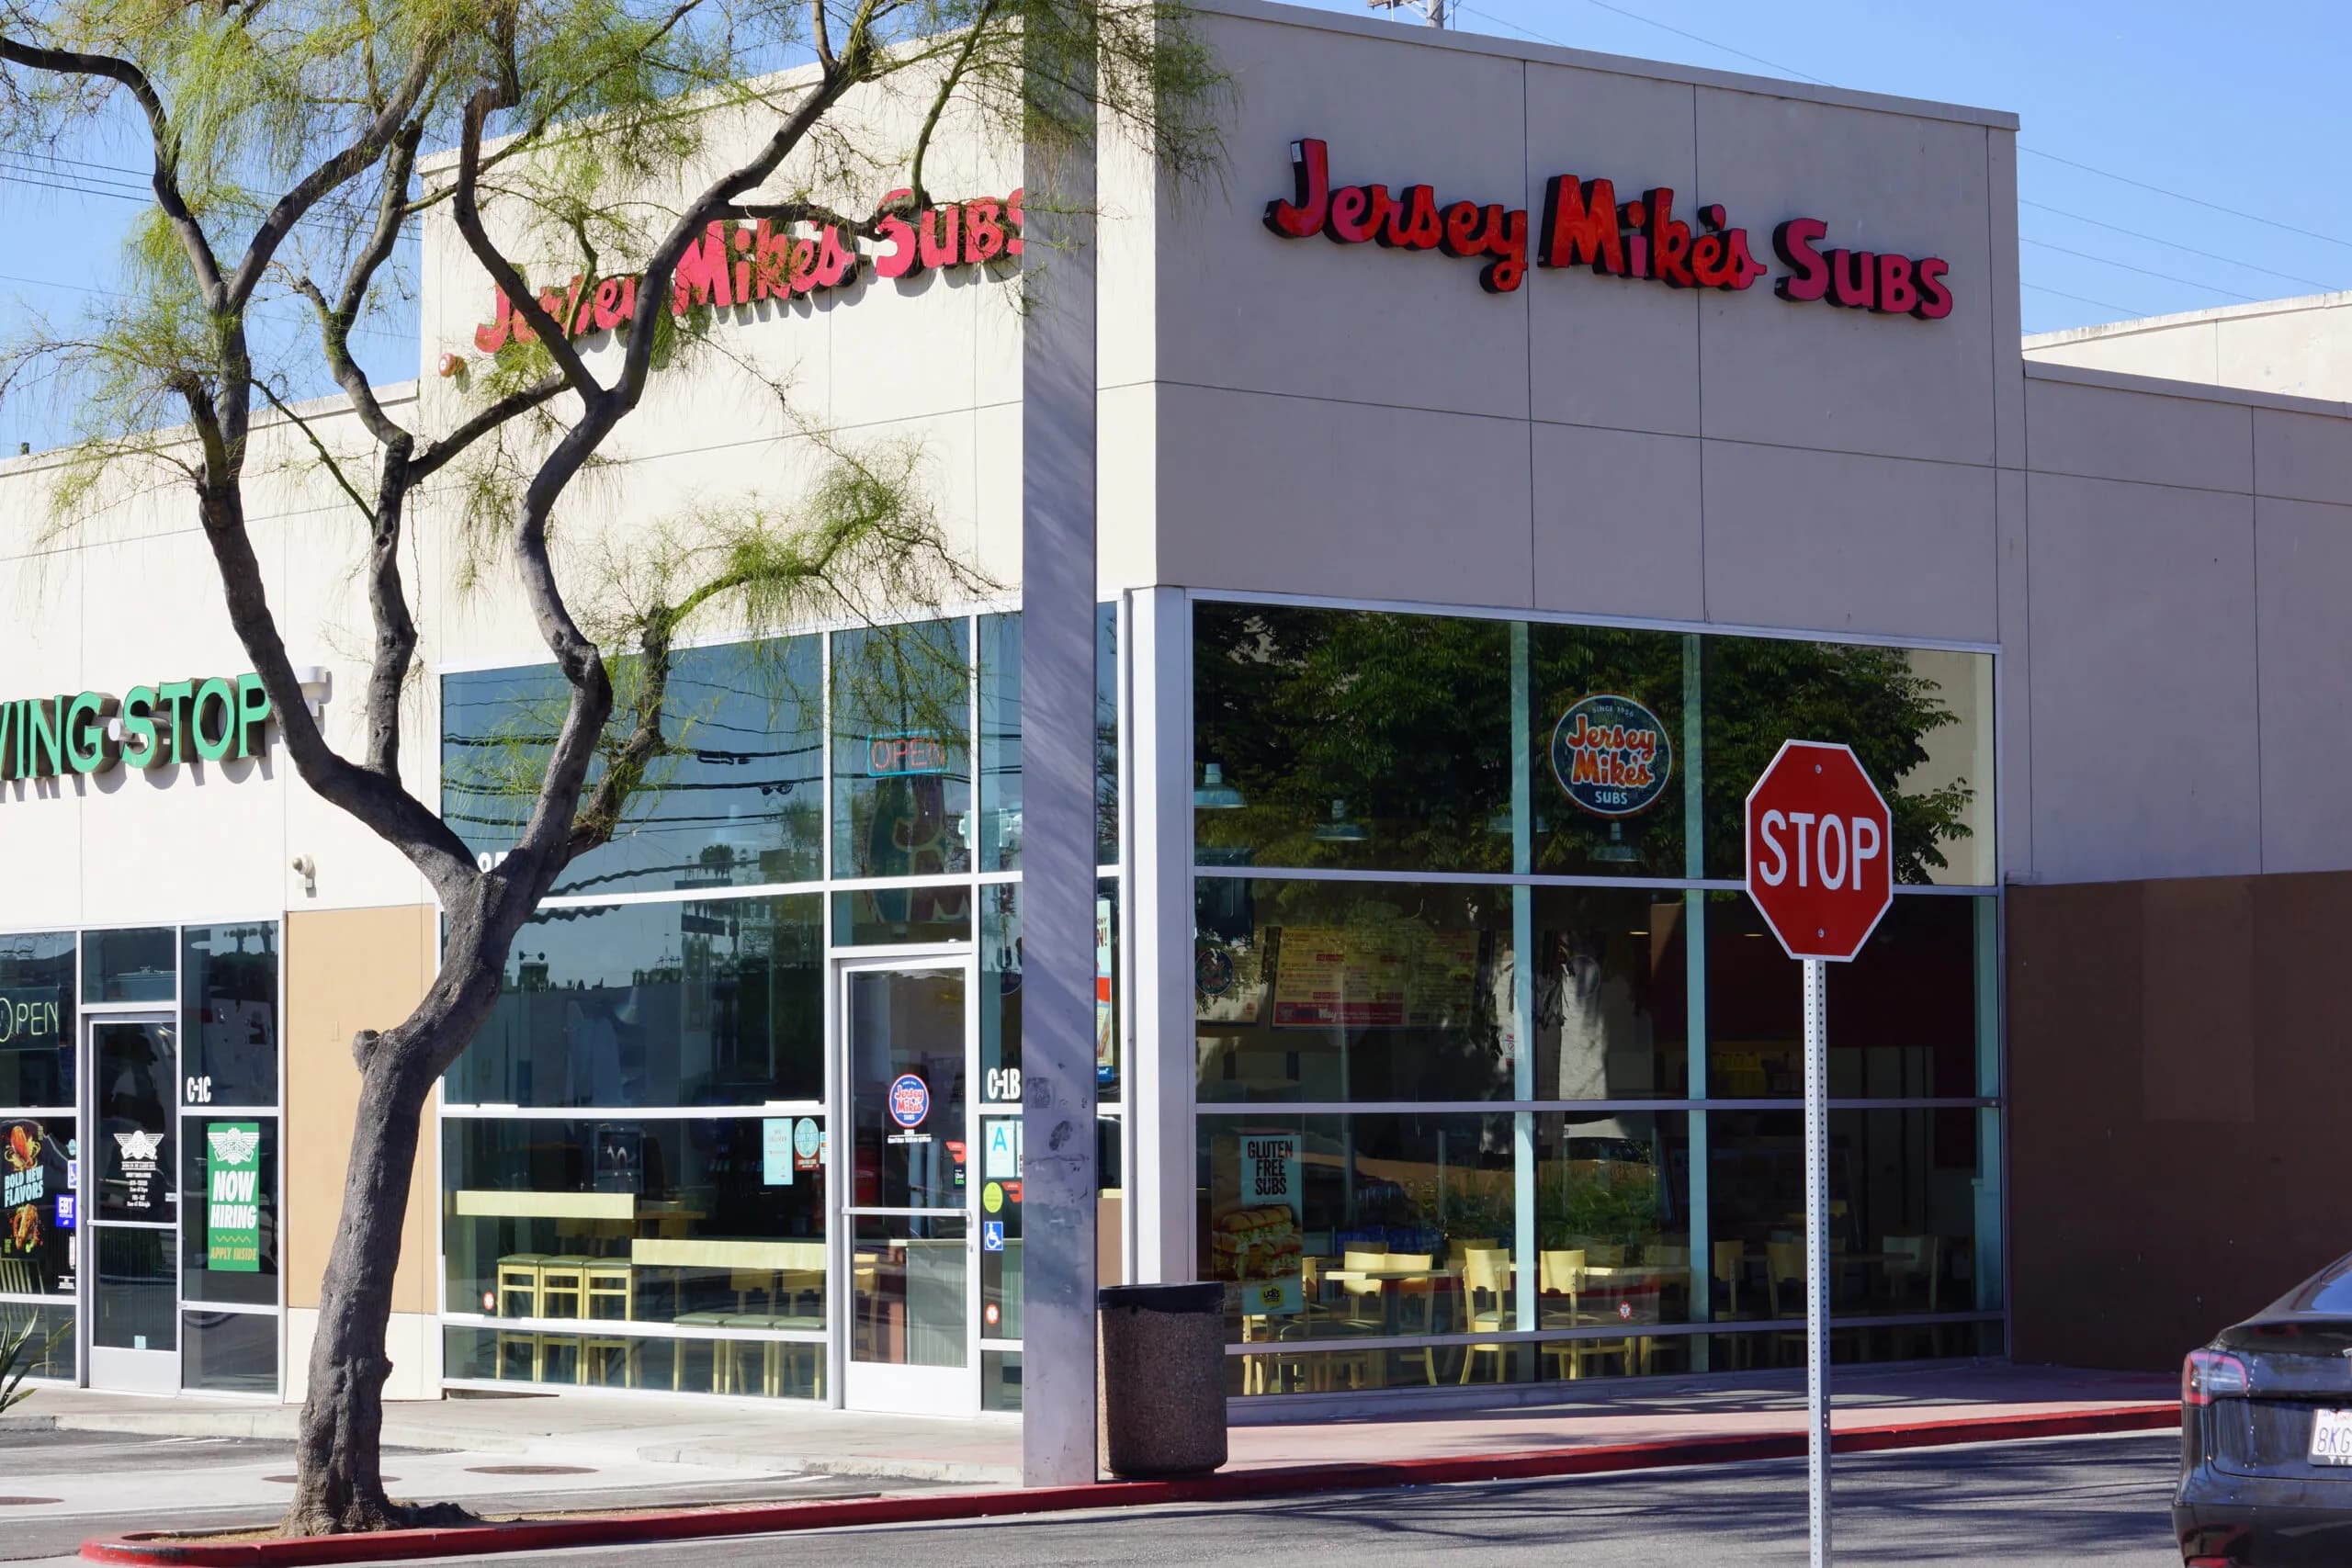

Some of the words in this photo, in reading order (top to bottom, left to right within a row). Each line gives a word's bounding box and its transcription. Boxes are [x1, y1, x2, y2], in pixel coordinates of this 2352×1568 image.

[1264, 139, 1527, 294] Jersey
[1538, 175, 1767, 290] Mike's
[1772, 217, 1952, 320] SUBS
[121, 673, 273, 769] STOP
[1566, 713, 1656, 761] Jersey
[872, 738, 945, 769] OPEN
[1571, 749, 1655, 788] Mike's
[1595, 791, 1627, 805] SUBS
[1758, 809, 1881, 890] STOP
[0, 997, 59, 1043] OPEN
[187, 1077, 211, 1102] C-1C
[895, 1085, 923, 1101] Jersey
[987, 1067, 1021, 1100] C-1B
[992, 1125, 1008, 1152] A
[1248, 1141, 1294, 1160] GLUTEN
[5, 1172, 24, 1190] BOLD
[26, 1165, 43, 1183] NEW
[1256, 1159, 1286, 1178] FREE
[5, 1180, 44, 1208] FLAVORS
[213, 1170, 257, 1202] NOW
[1255, 1179, 1287, 1196] SUBS
[59, 1197, 74, 1213] EBT
[210, 1204, 257, 1229] HIRING
[210, 1247, 232, 1260] APPLY
[233, 1247, 257, 1261] INSIDE
